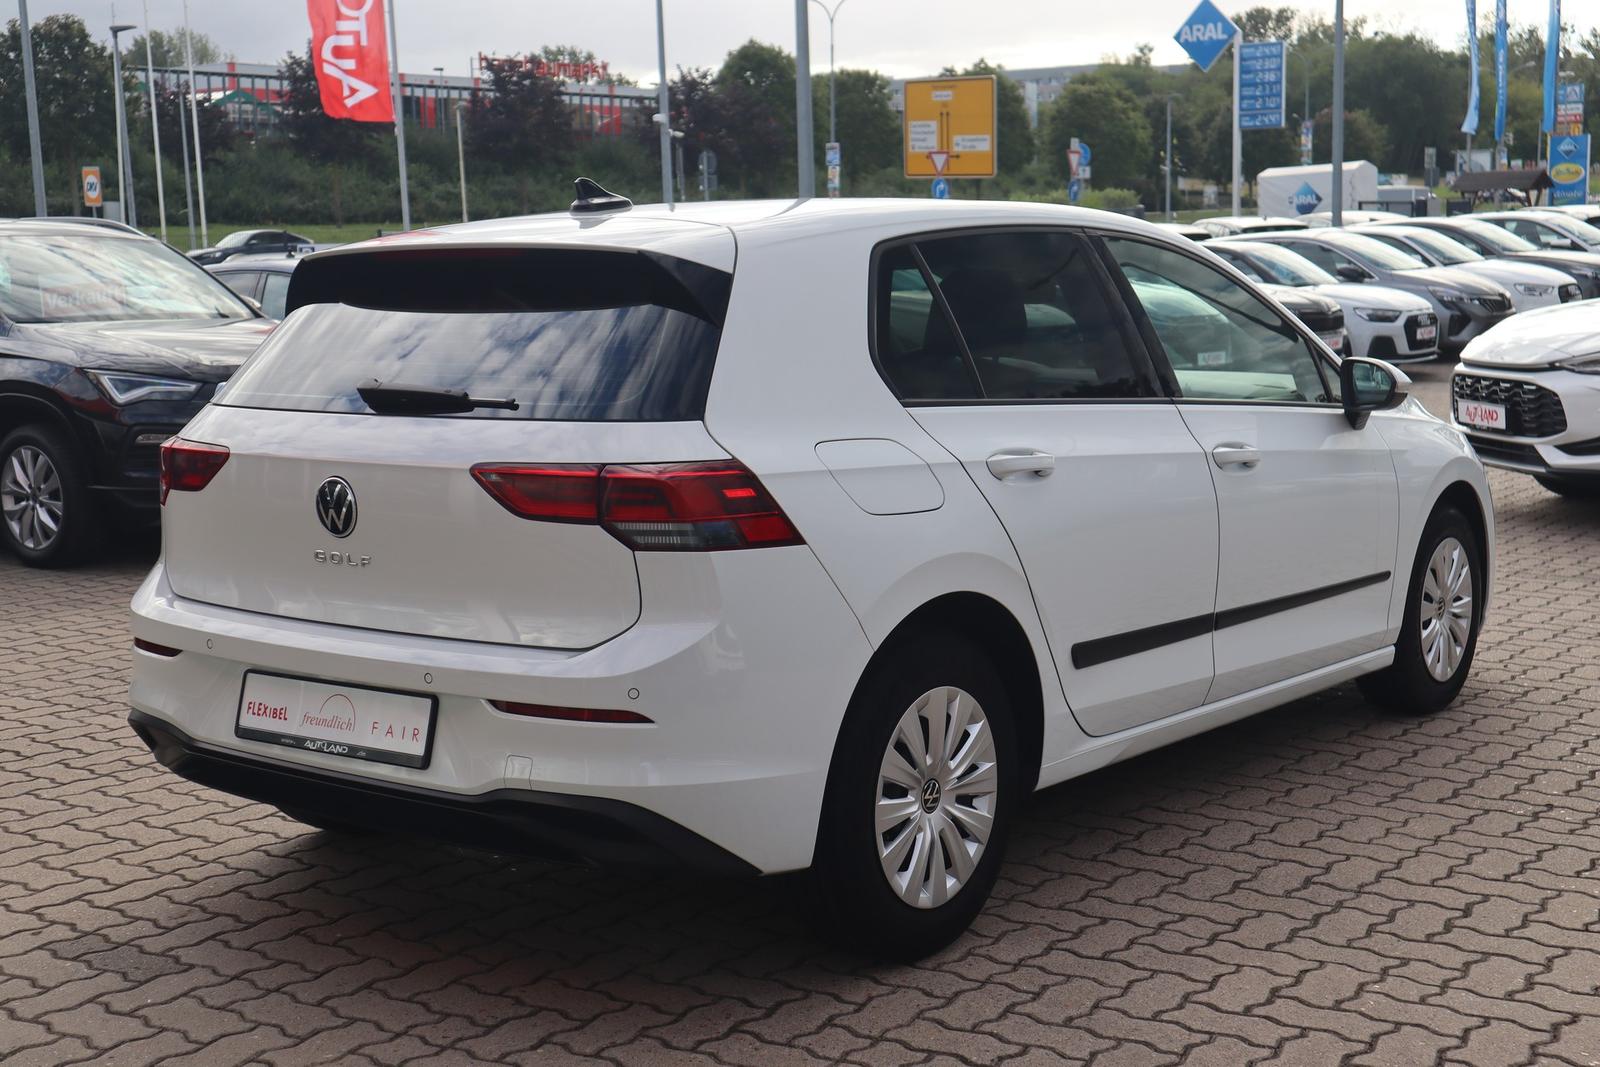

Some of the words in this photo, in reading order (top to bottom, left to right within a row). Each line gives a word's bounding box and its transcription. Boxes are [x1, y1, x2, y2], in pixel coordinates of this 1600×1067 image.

[1180, 22, 1228, 42] ARAL
[314, 549, 371, 567] GOLF
[246, 701, 288, 721] FLEXIBEL
[300, 711, 353, 731] freundlich
